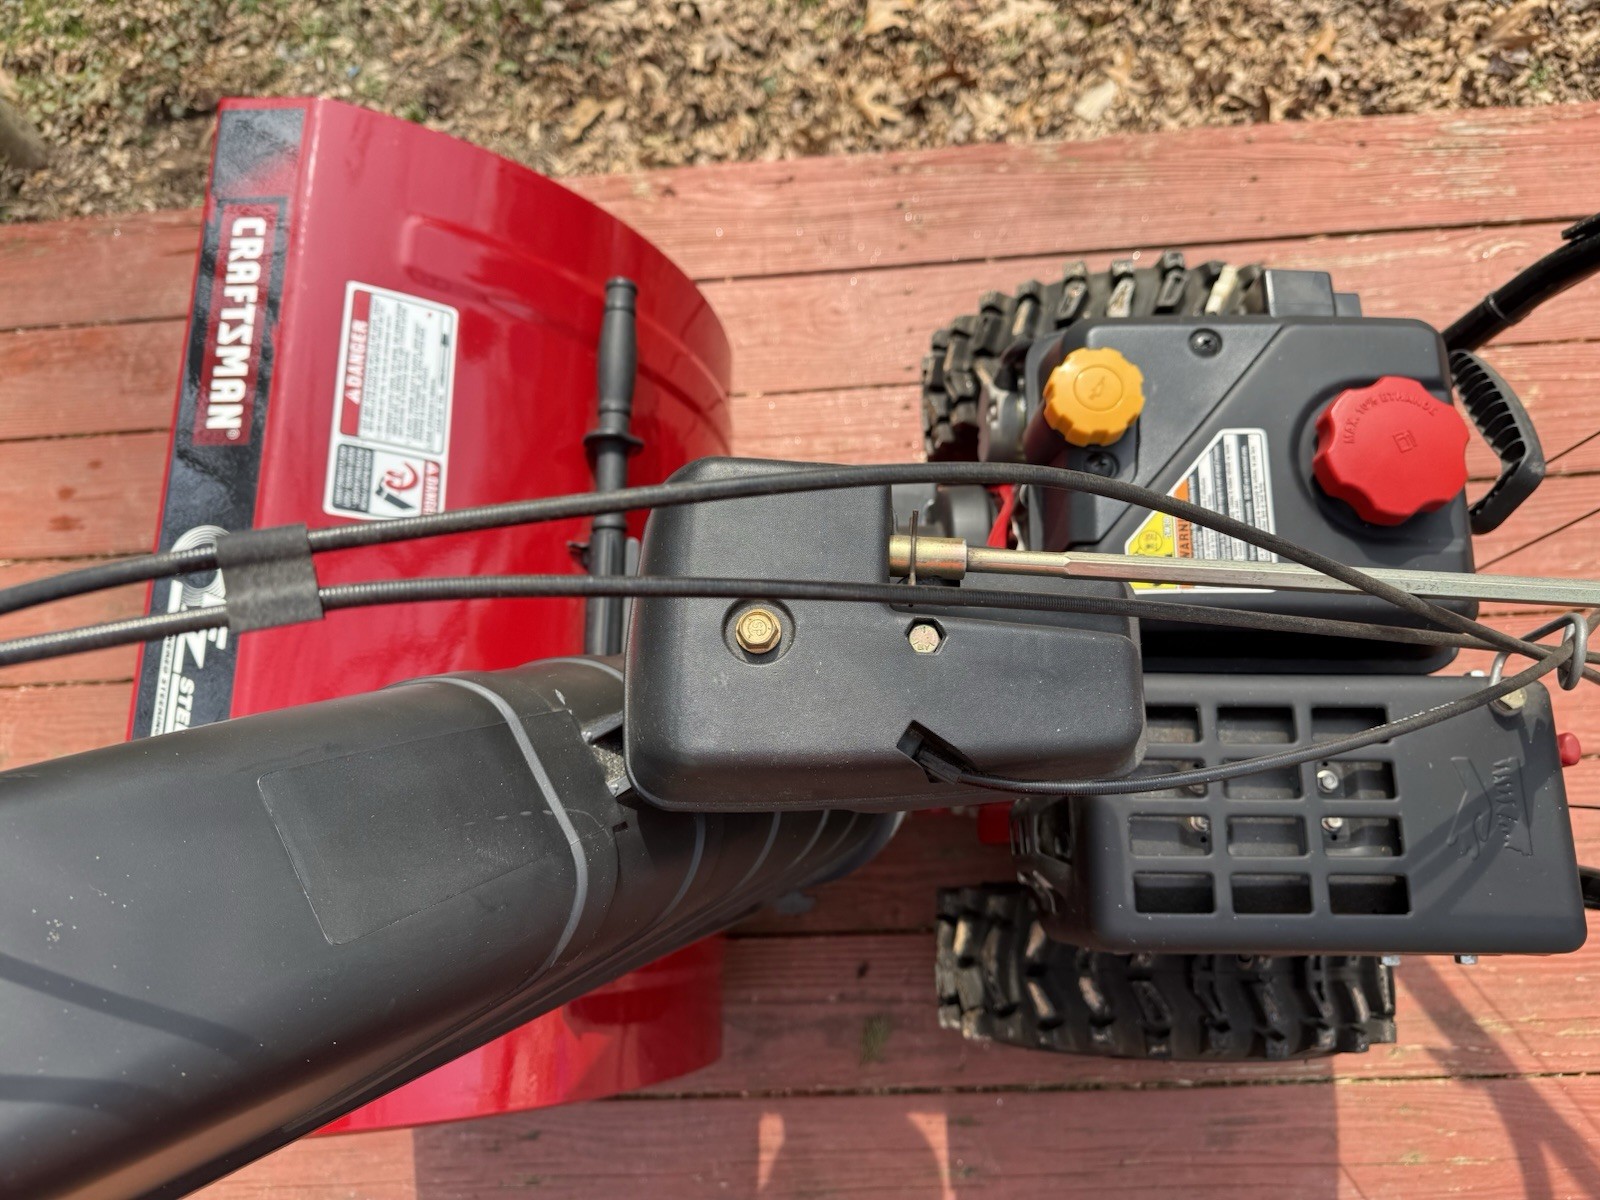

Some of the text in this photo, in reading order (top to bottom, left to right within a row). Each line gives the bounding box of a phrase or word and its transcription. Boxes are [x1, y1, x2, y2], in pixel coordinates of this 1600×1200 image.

[345, 318, 368, 388] DANGER
[421, 475, 439, 515] DANGE
[1177, 520, 1190, 558] WARN
[173, 676, 195, 731] STE
